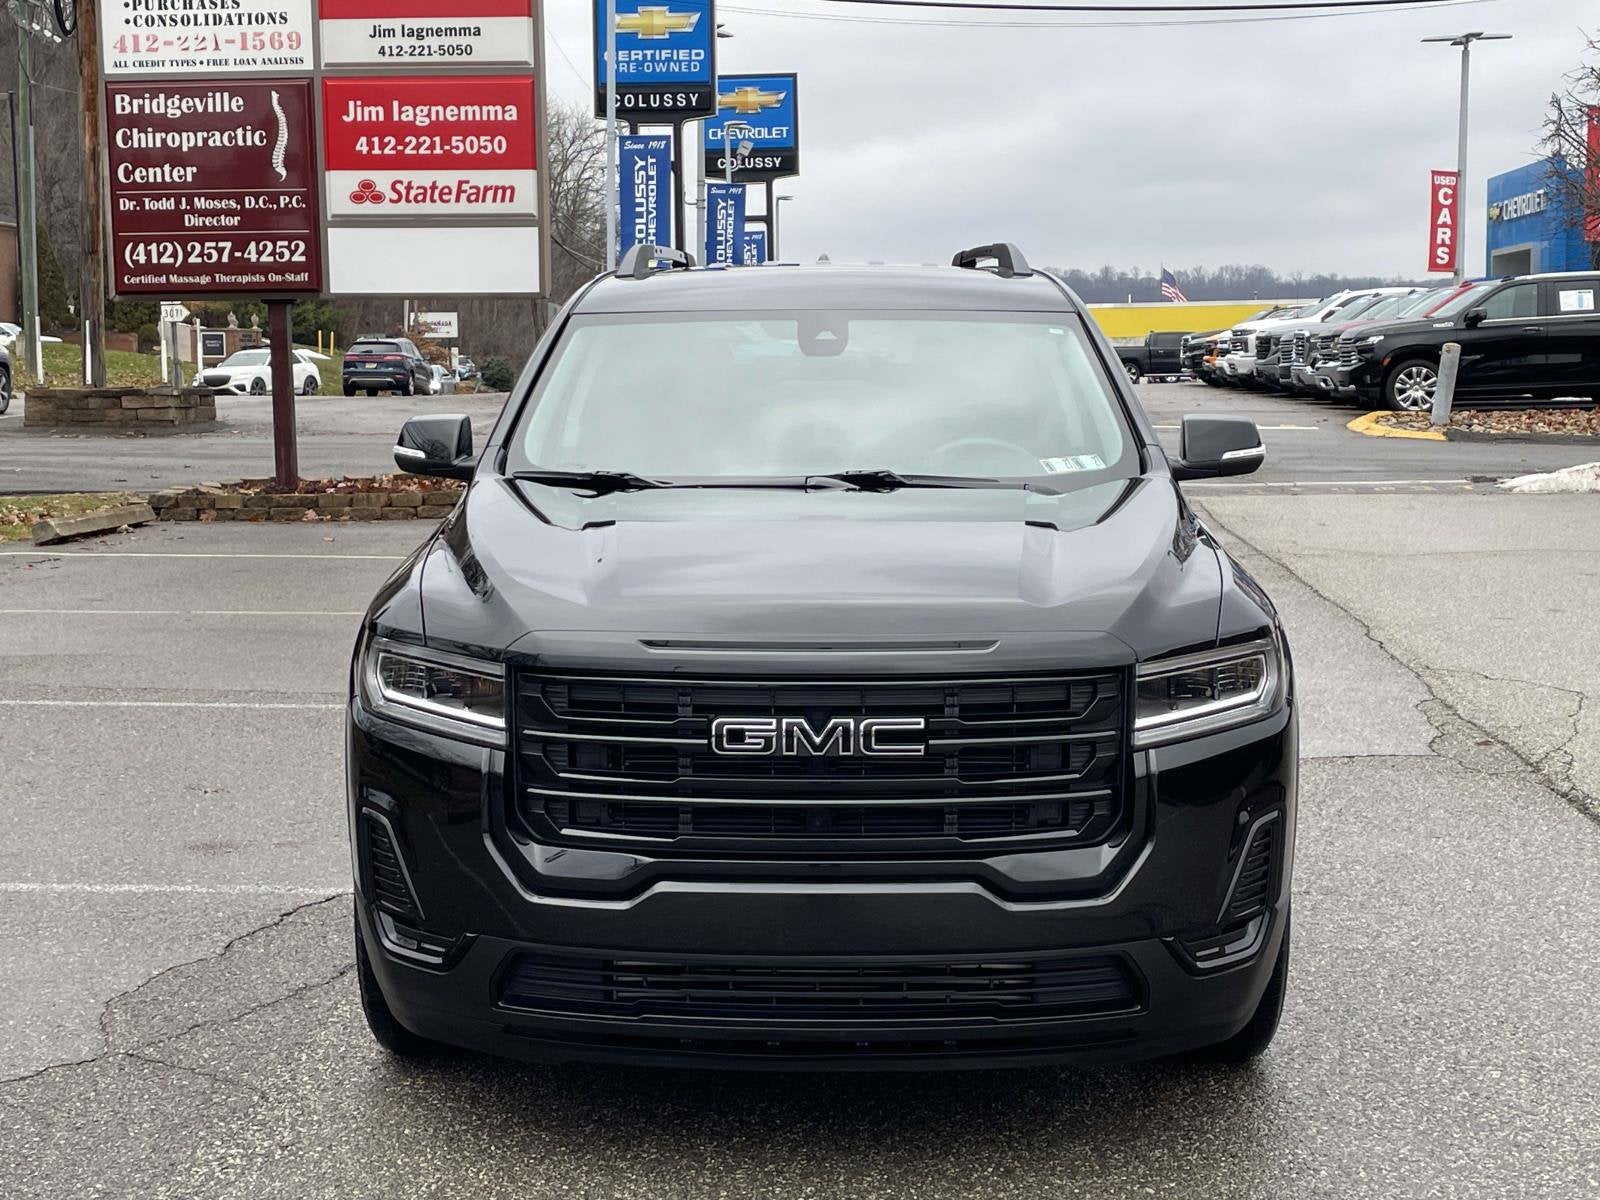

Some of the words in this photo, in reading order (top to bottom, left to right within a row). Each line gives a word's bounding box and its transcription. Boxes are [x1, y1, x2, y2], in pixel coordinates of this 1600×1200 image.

[133, 11, 289, 27] CONSOLIDATIONS
[113, 31, 302, 53] 412-221-1569
[369, 25, 396, 39] Jim
[401, 25, 481, 41] Iagnemma
[378, 44, 473, 57] 412-221-5050
[112, 60, 129, 68] ALL
[132, 60, 166, 68] CREDIT
[170, 59, 197, 67] TYPES
[206, 58, 230, 66] FREE
[234, 58, 257, 66] LOAN
[260, 57, 304, 65] ANALYSIS
[115, 92, 244, 118] Bridgeville
[342, 100, 384, 122] Jim
[392, 100, 518, 126] Iagnemma
[115, 126, 267, 151] Chiropractic
[708, 126, 789, 140] CHEVROLET
[355, 135, 507, 155] 412-221-5050
[624, 141, 645, 150] Since
[648, 140, 667, 149] 1918
[117, 162, 197, 183] Center
[1434, 175, 1456, 185] USED
[119, 198, 140, 211] Dr.
[143, 198, 175, 211] Todd
[179, 198, 190, 210] J.
[194, 197, 241, 211] Moses,
[244, 196, 277, 209] D.C.,
[280, 195, 306, 208] P.C.
[1503, 189, 1545, 220] CHEVROLET
[184, 213, 241, 227] Director
[716, 198, 727, 262] OLUSSY
[1436, 187, 1453, 265] CARS
[124, 241, 184, 268] (412)
[187, 240, 306, 263] 257-4252
[124, 274, 167, 284] Certified
[169, 274, 211, 285] Massage
[214, 273, 266, 284] Therapists
[268, 272, 309, 282] On-Staff
[711, 716, 926, 756] GMC
